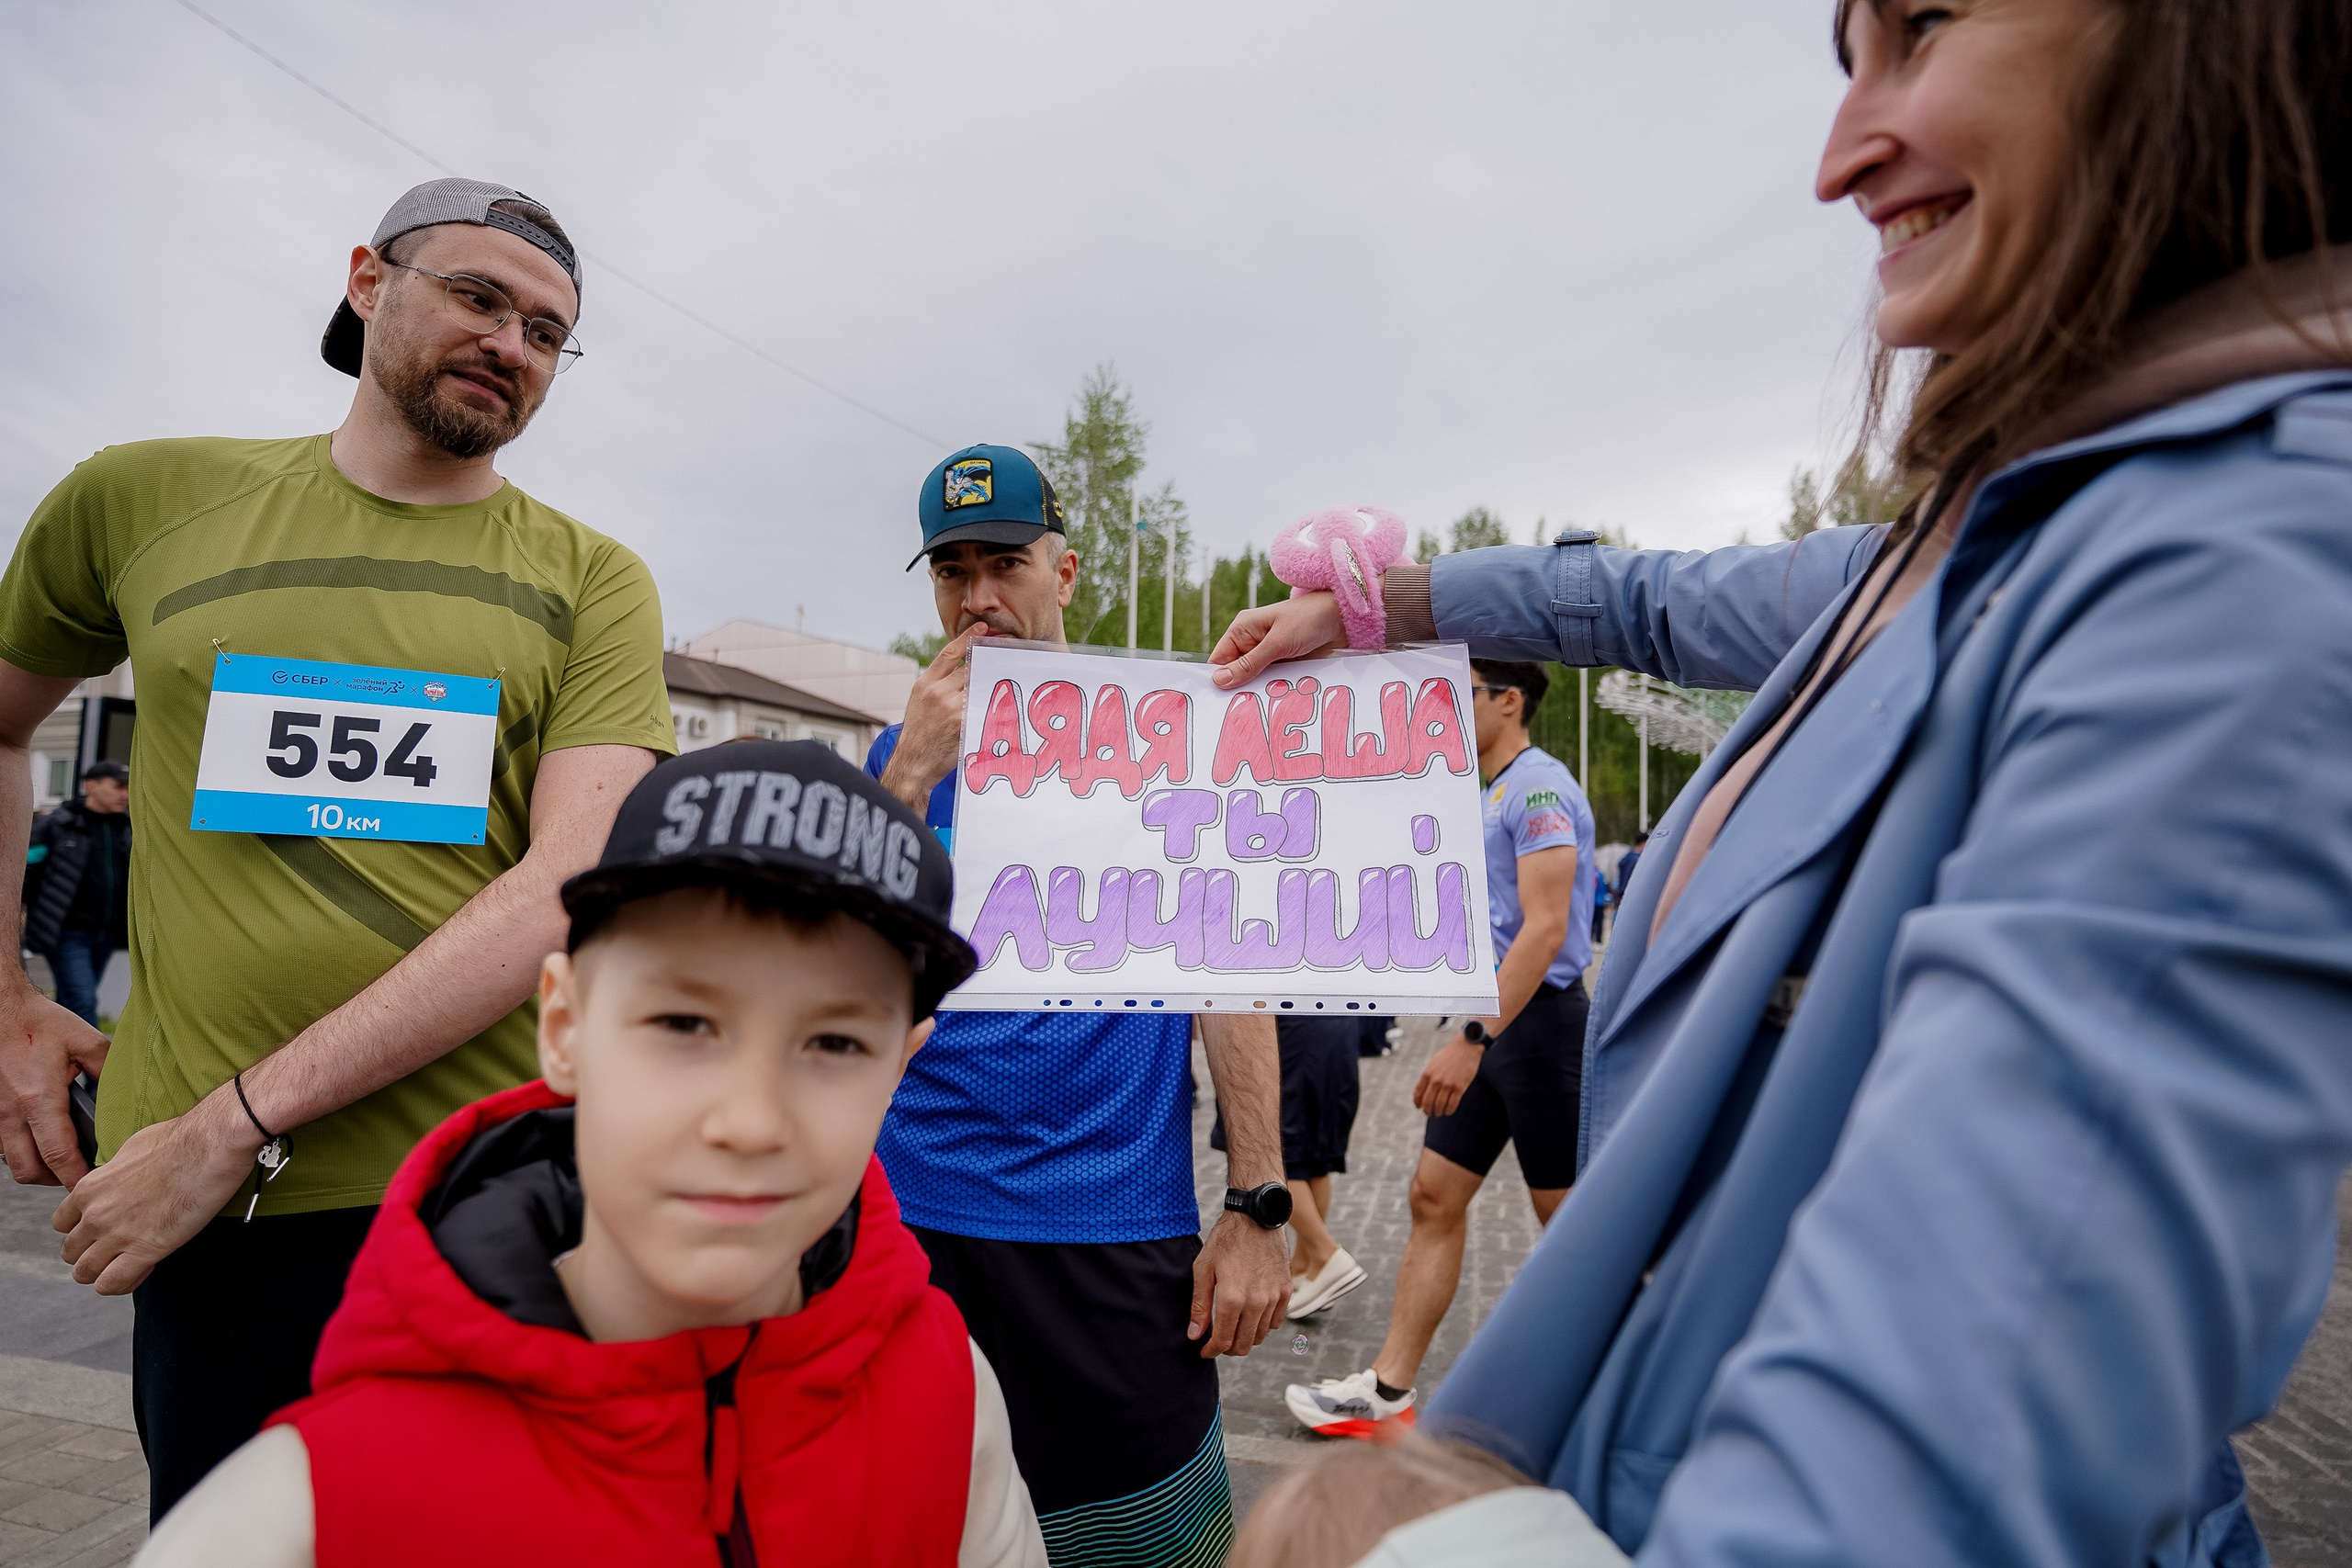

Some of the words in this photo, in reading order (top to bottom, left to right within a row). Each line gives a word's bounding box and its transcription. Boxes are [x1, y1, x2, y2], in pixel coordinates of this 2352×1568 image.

[291, 674, 329, 685] СБЕР
[345, 683, 384, 693] марафон
[352, 677, 388, 686] зелёный
[266, 711, 437, 787] 554
[965, 679, 1193, 801] ДЯДЯ
[1212, 676, 1474, 787] ЛЁША
[307, 804, 344, 829] 10
[655, 770, 922, 901] STRONG
[1141, 787, 1321, 863] ТЫ
[967, 814, 1476, 974] ЛУЧШИЙ
